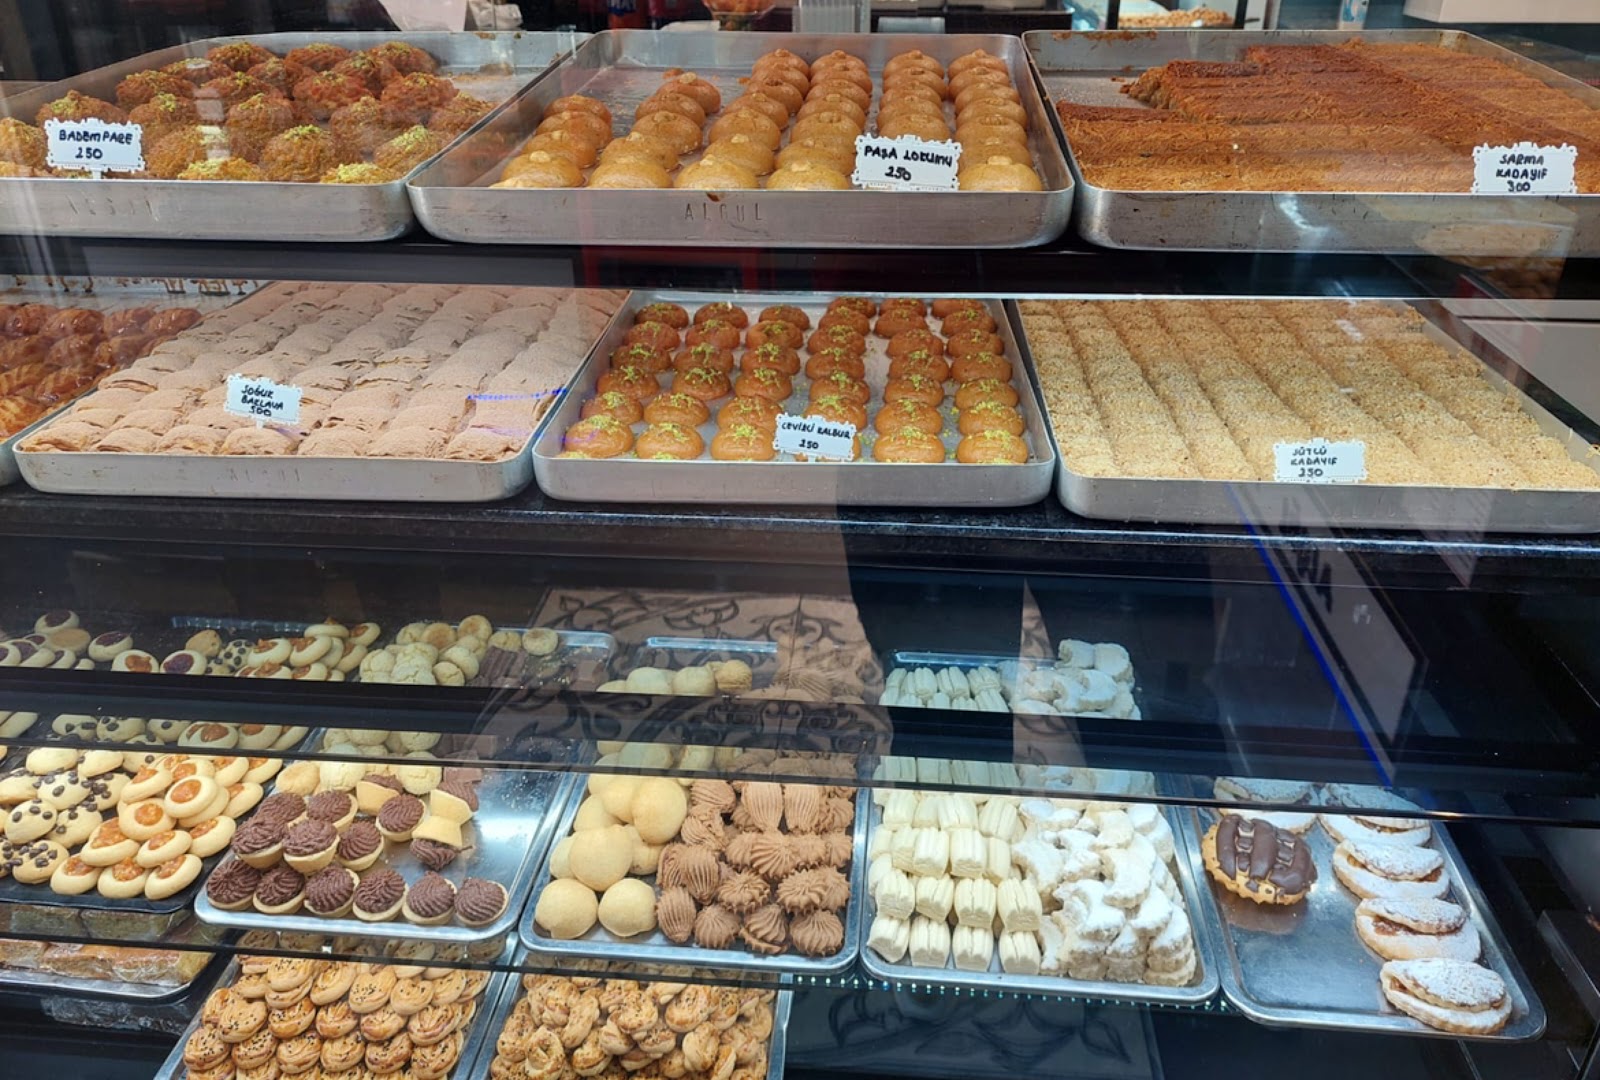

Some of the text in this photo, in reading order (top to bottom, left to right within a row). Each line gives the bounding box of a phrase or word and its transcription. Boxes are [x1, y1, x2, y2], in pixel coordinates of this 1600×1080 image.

[58, 129, 101, 143] BADEM
[864, 145, 898, 160] PAŞA
[1499, 154, 1544, 166] SARMA
[885, 166, 912, 181] 250
[1496, 168, 1548, 181] KADAYIF
[1507, 180, 1531, 192] 300
[249, 406, 272, 416] 500
[1290, 457, 1338, 466] KADAYIF
